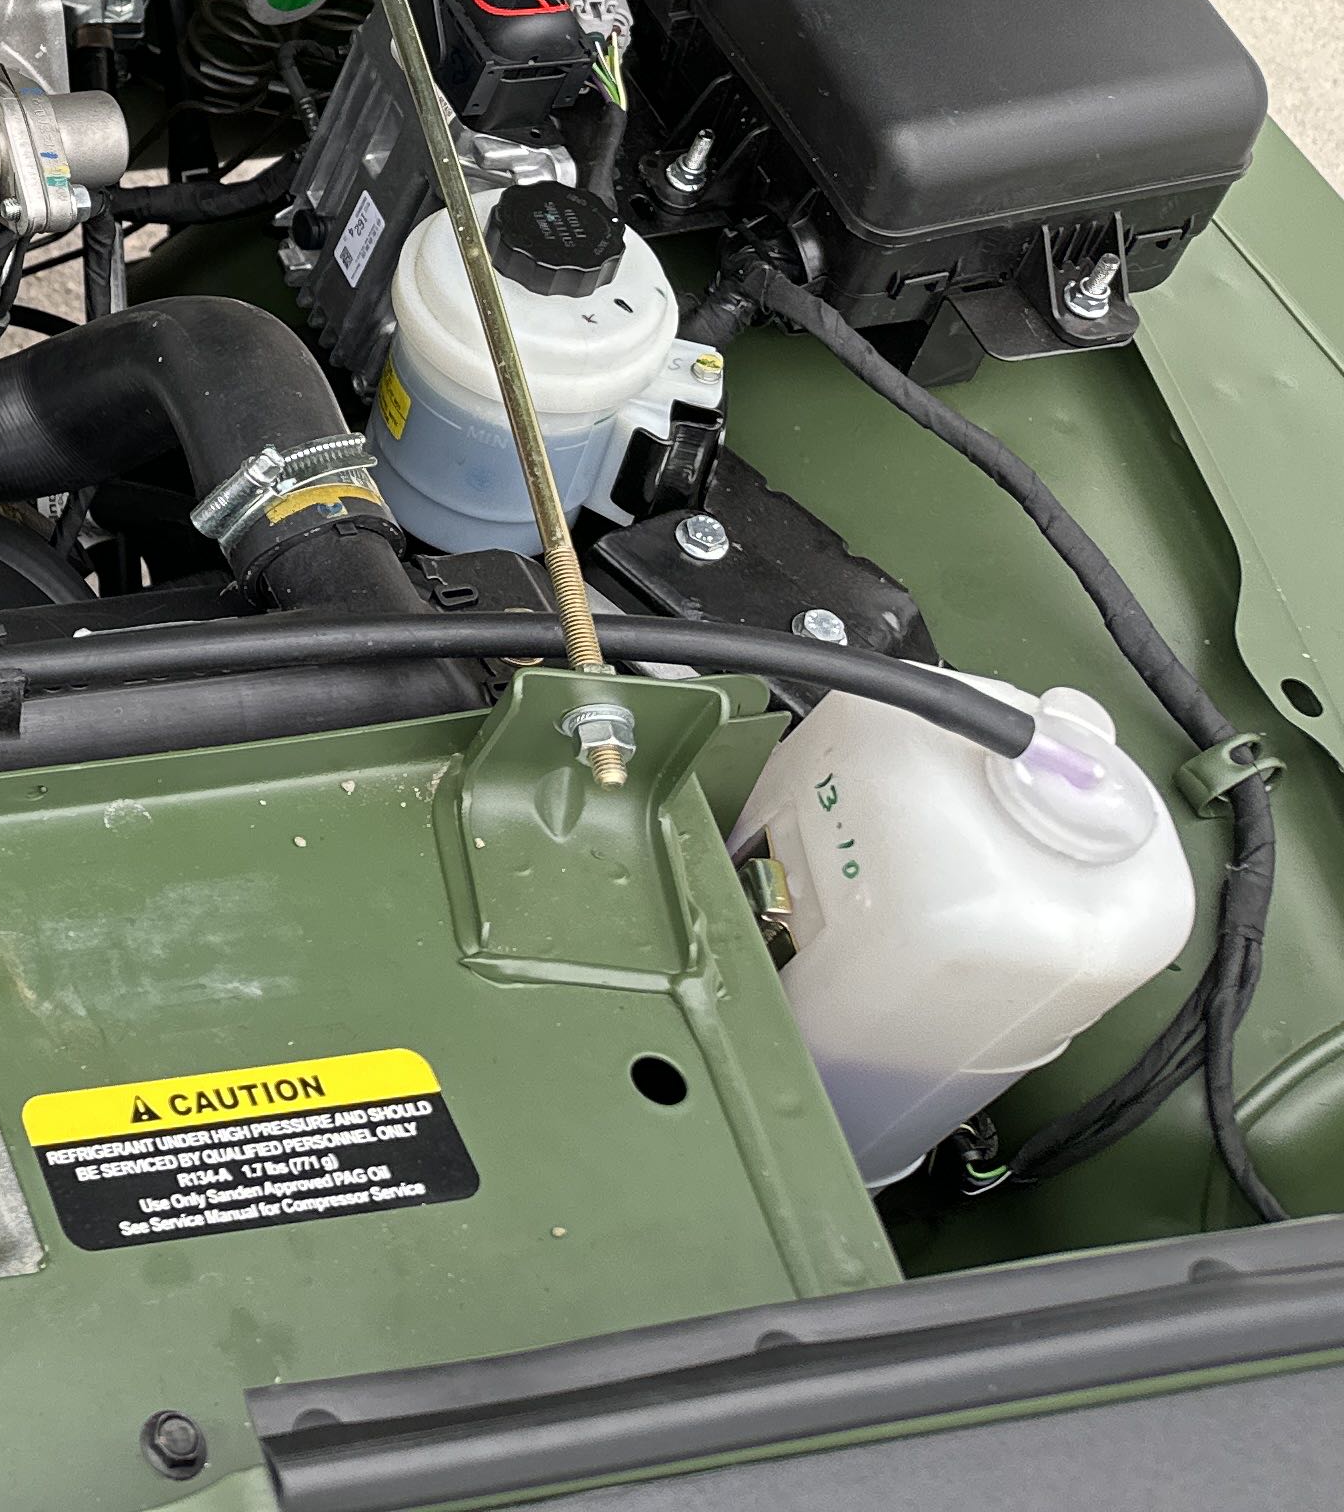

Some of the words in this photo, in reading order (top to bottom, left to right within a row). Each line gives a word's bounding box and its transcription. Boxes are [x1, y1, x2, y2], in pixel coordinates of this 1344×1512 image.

[168, 1075, 325, 1115] CAUTION
[45, 1138, 153, 1165] REFRIGERANT
[155, 1130, 212, 1150] UNDER
[210, 1125, 251, 1142] HIGH
[250, 1113, 334, 1137] PRESSURE
[334, 1109, 367, 1126] AND
[367, 1100, 432, 1121] SHOULD
[75, 1165, 100, 1181] BE
[100, 1154, 178, 1177] SERVICED
[177, 1151, 200, 1167] BY
[201, 1140, 282, 1163] QUALIFIED
[282, 1128, 377, 1152] PERSONNEL
[375, 1121, 416, 1139] ONLY
[139, 1198, 170, 1212] Use
[170, 1192, 205, 1208] Only
[205, 1185, 263, 1203] Sanden
[264, 1173, 333, 1196] Approved
[332, 1168, 367, 1185] PAG
[367, 1165, 390, 1180] Oil
[176, 1167, 232, 1187] R134-A
[241, 1162, 262, 1177] 1.7
[263, 1161, 289, 1174] lbs
[288, 1155, 319, 1174] (771
[320, 1153, 338, 1170] g)
[119, 1220, 149, 1235] See
[149, 1213, 204, 1231] Service
[204, 1204, 258, 1223] Manual
[258, 1202, 280, 1215] for
[281, 1190, 369, 1212] Compressor
[369, 1182, 425, 1200] Service
